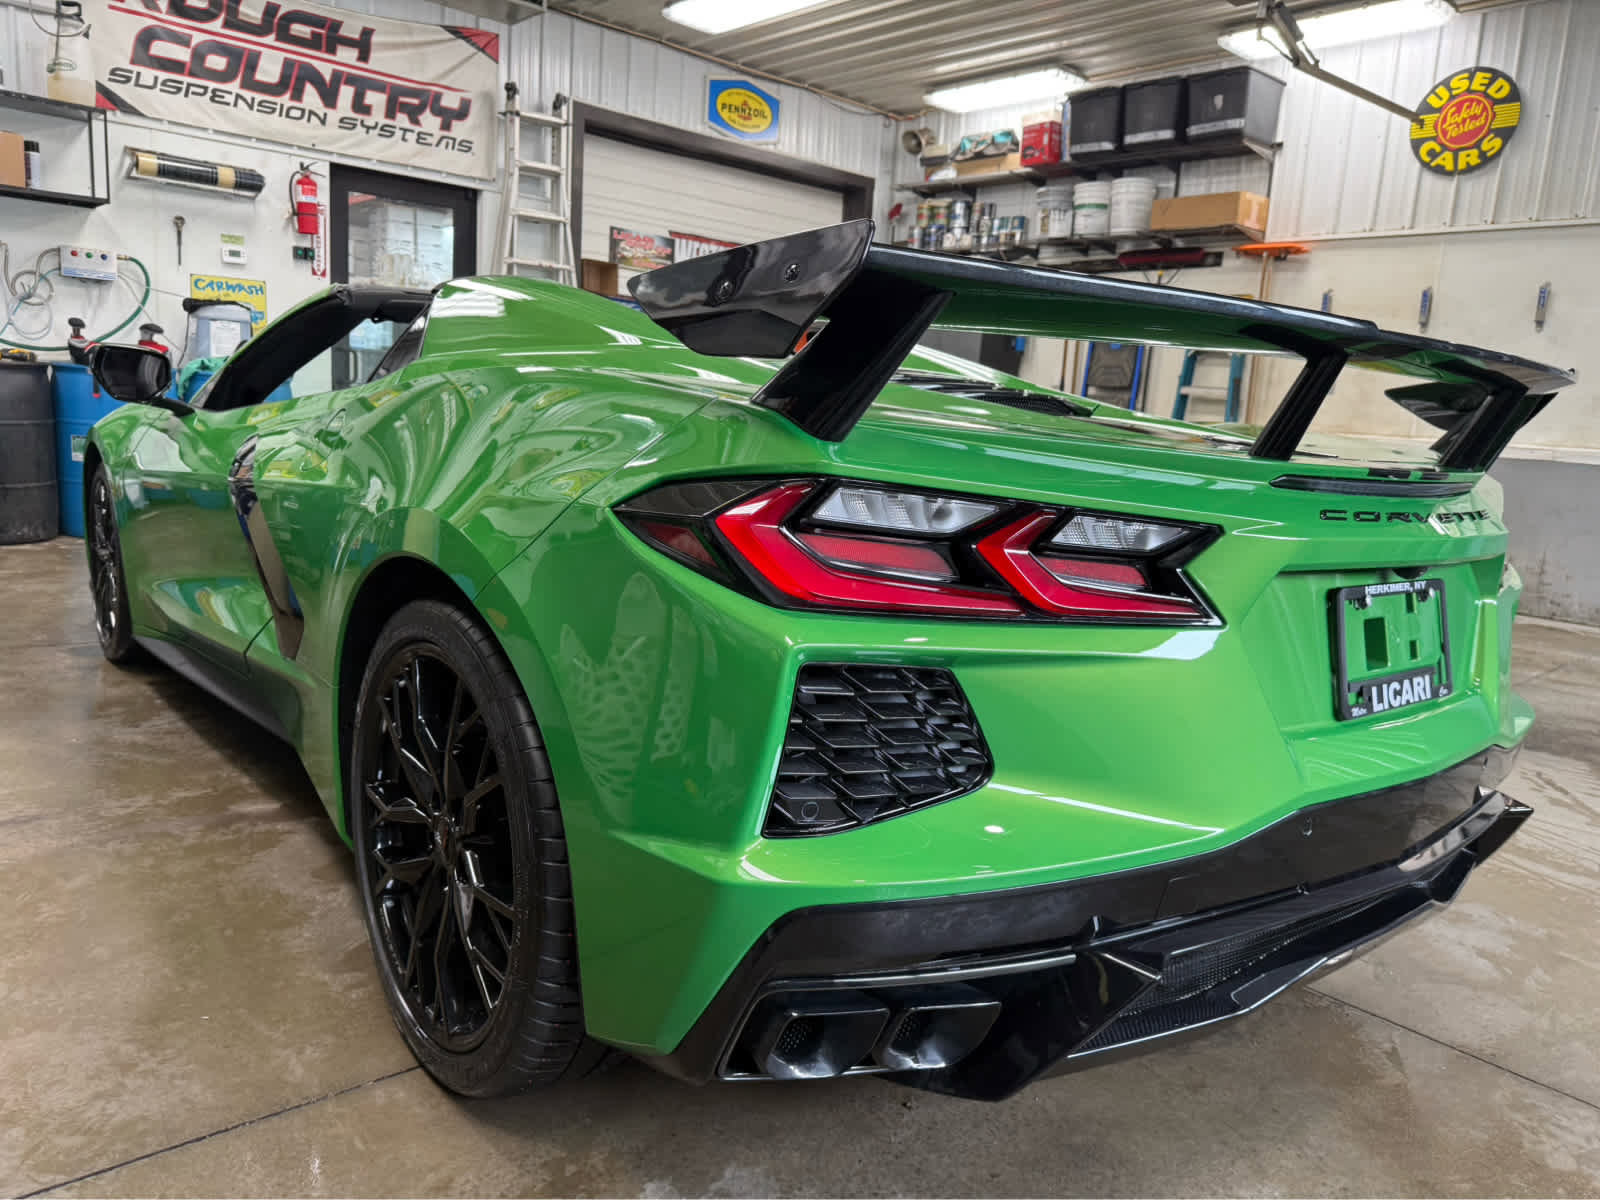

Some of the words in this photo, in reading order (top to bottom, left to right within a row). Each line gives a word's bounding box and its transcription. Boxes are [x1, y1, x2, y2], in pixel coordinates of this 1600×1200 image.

[130, 24, 473, 133] COUNTRY
[1426, 71, 1511, 108] USED
[107, 66, 328, 126] SUSPENSION
[338, 116, 474, 154] SYSTEMS
[720, 101, 769, 120] PENNZOIL
[1419, 133, 1503, 171] CARS
[1319, 509, 1491, 524] CORVETTE
[1371, 674, 1432, 712] LICARI
